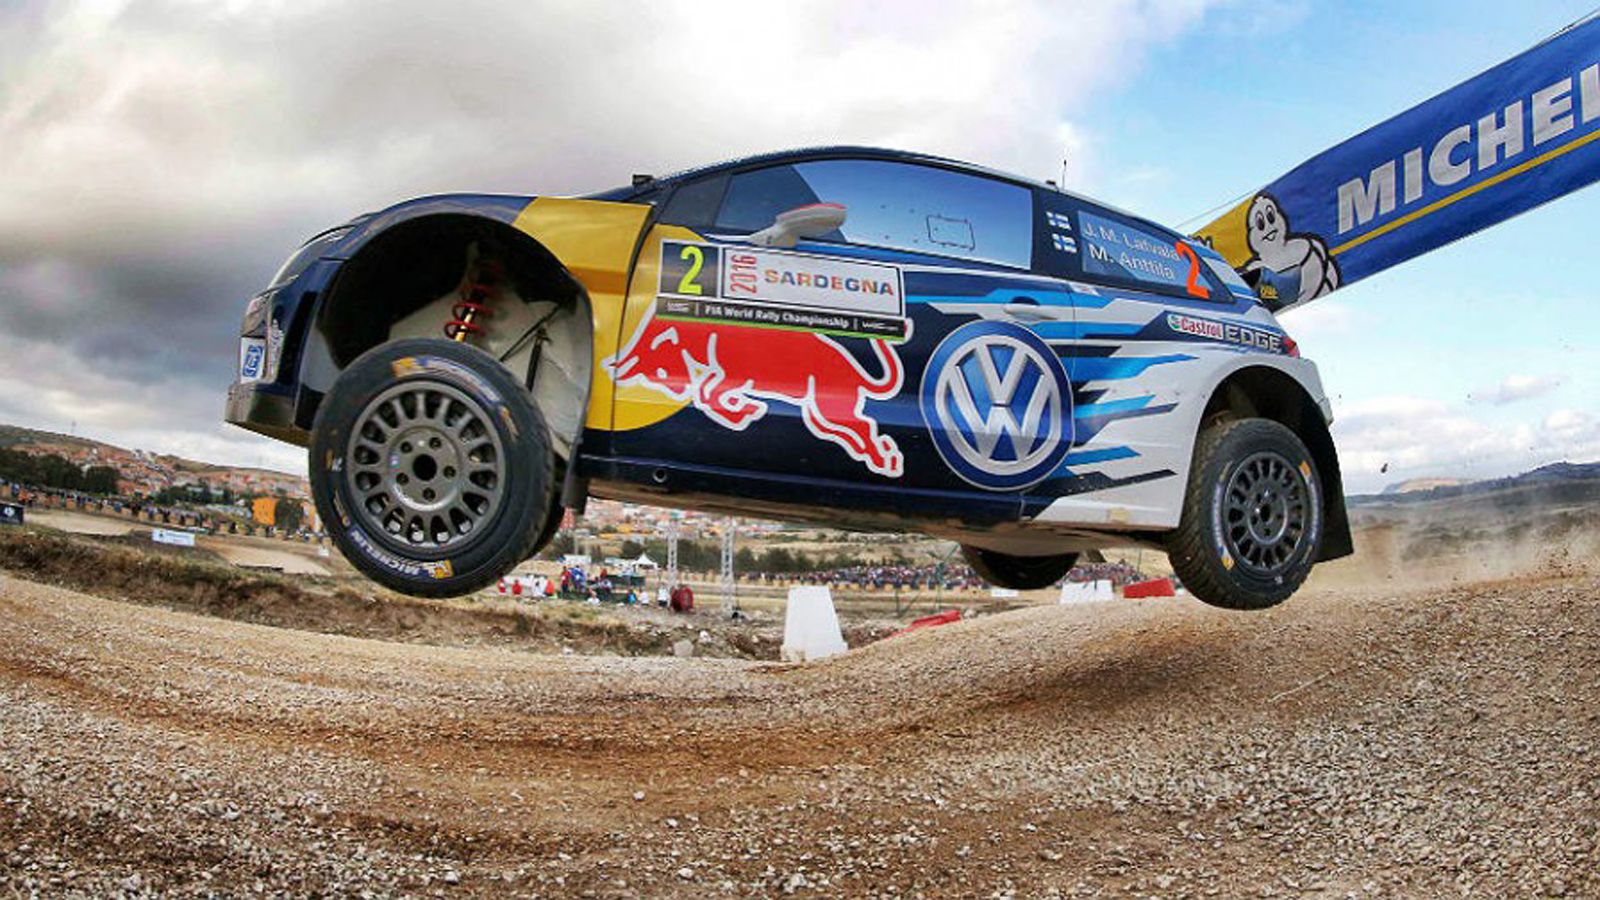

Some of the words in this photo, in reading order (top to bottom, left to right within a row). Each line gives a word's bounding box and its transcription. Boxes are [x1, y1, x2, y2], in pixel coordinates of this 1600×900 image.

[678, 246, 704, 295] 2
[729, 254, 757, 294] 2016
[1088, 243, 1113, 263] M.
[1120, 251, 1175, 279] Anttila
[1174, 241, 1209, 299] 2
[764, 268, 894, 296] SARDEGNA
[723, 306, 753, 319] World
[755, 309, 779, 323] Rally
[782, 312, 849, 329] Championship
[1180, 317, 1223, 338] Castrol
[1225, 324, 1281, 353] EDGE
